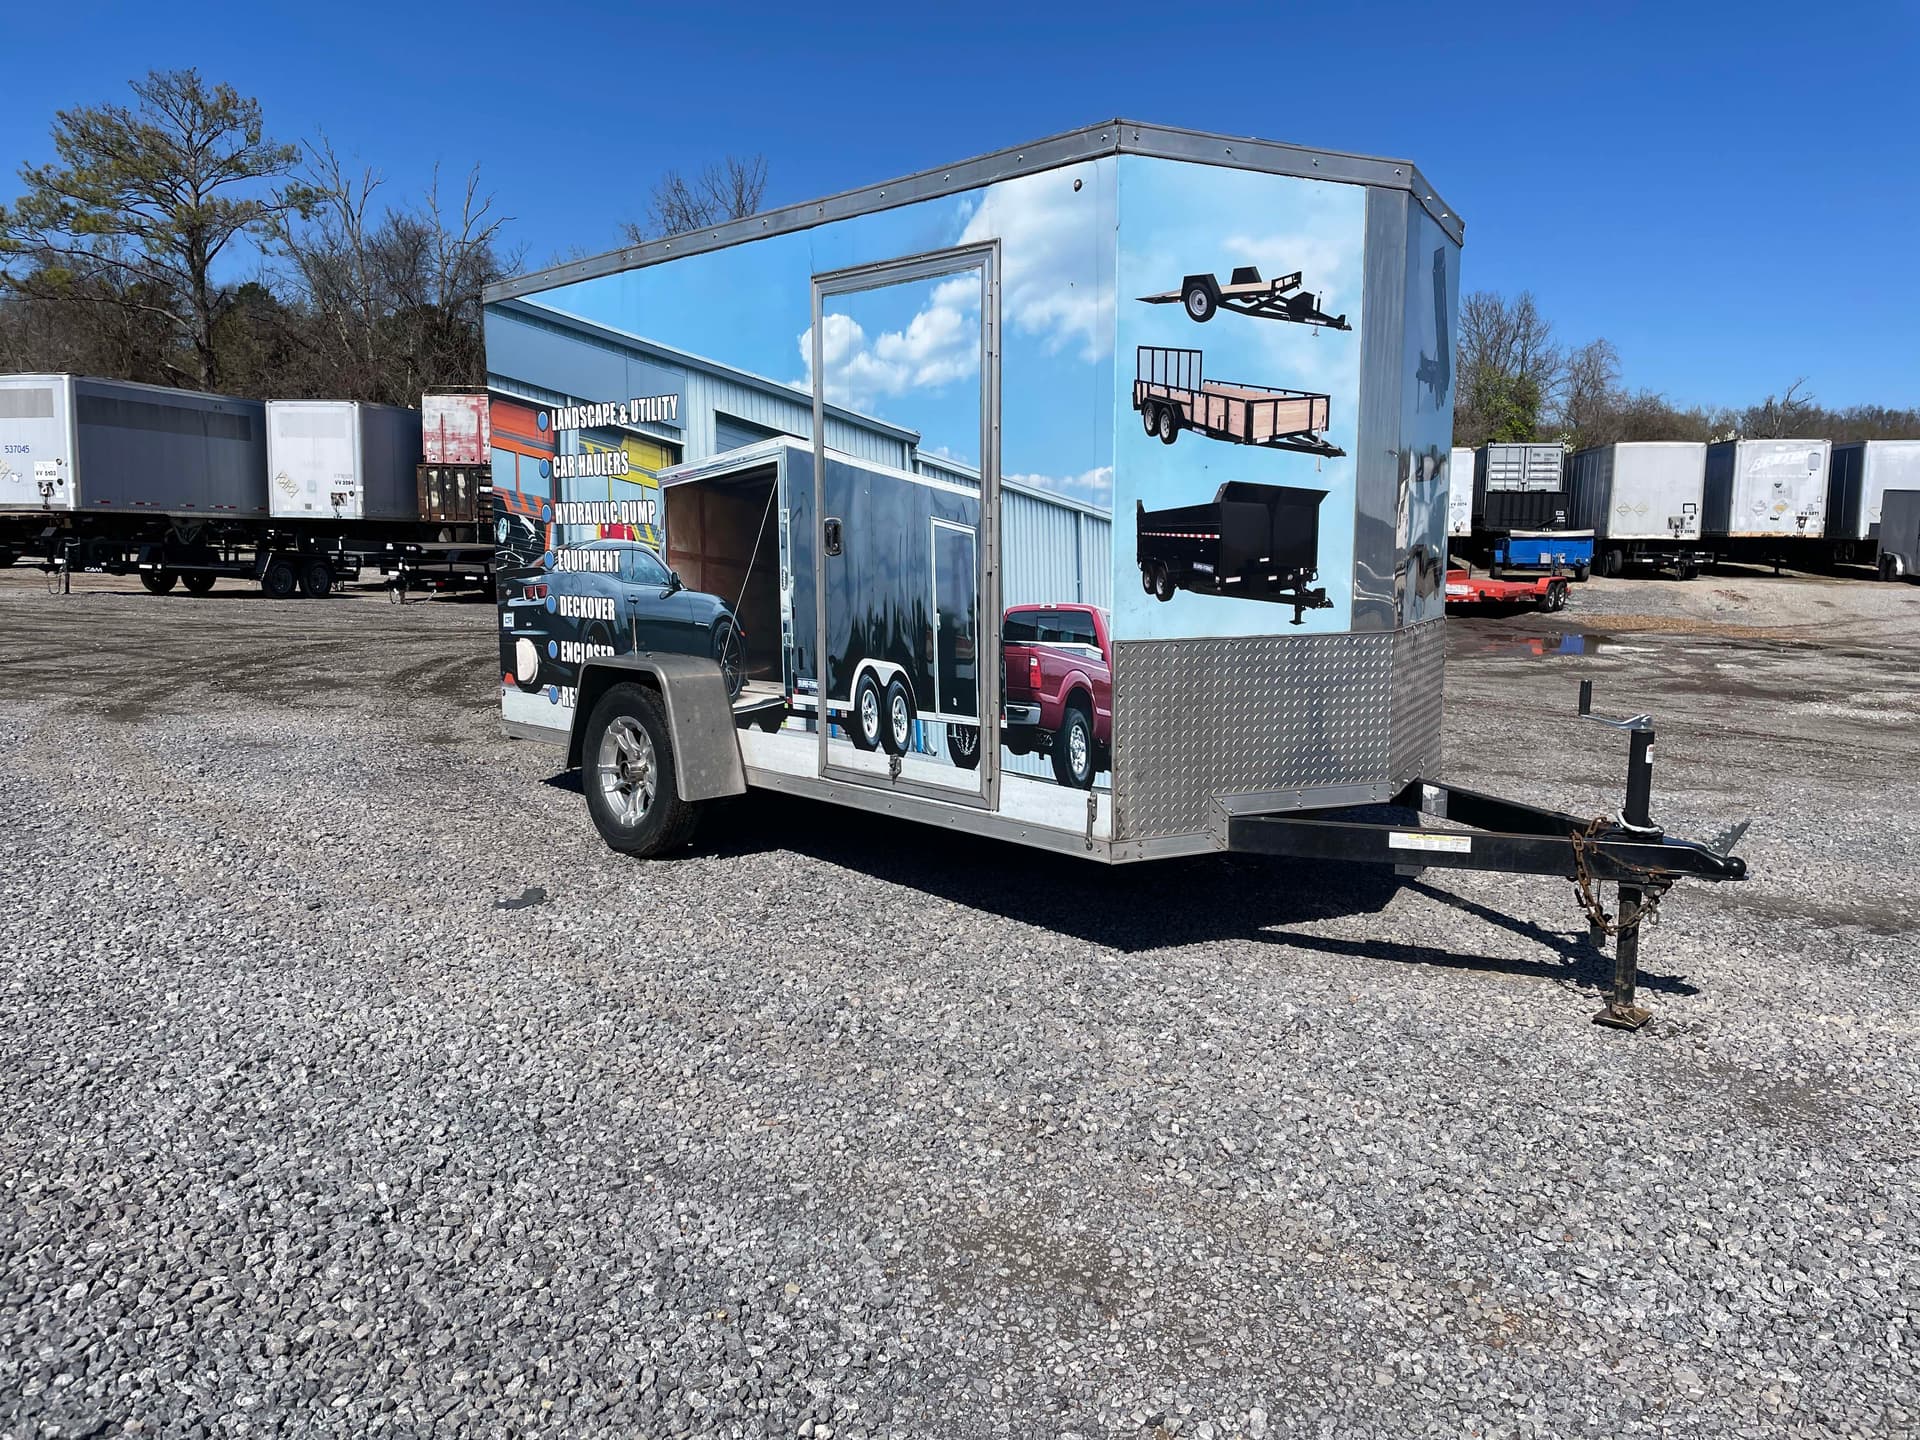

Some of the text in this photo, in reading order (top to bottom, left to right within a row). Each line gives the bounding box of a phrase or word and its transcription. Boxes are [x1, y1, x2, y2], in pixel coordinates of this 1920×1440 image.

[551, 394, 678, 431] LANDSCAPE & UTILITY
[4, 444, 30, 454] 537045
[552, 451, 629, 478] CAR HAULERS
[554, 499, 656, 525] HYDRAULIC DUMP
[557, 549, 620, 573] EQUIPMENT
[559, 595, 616, 621] DECKOVER
[560, 640, 616, 665] ENCLOSED
